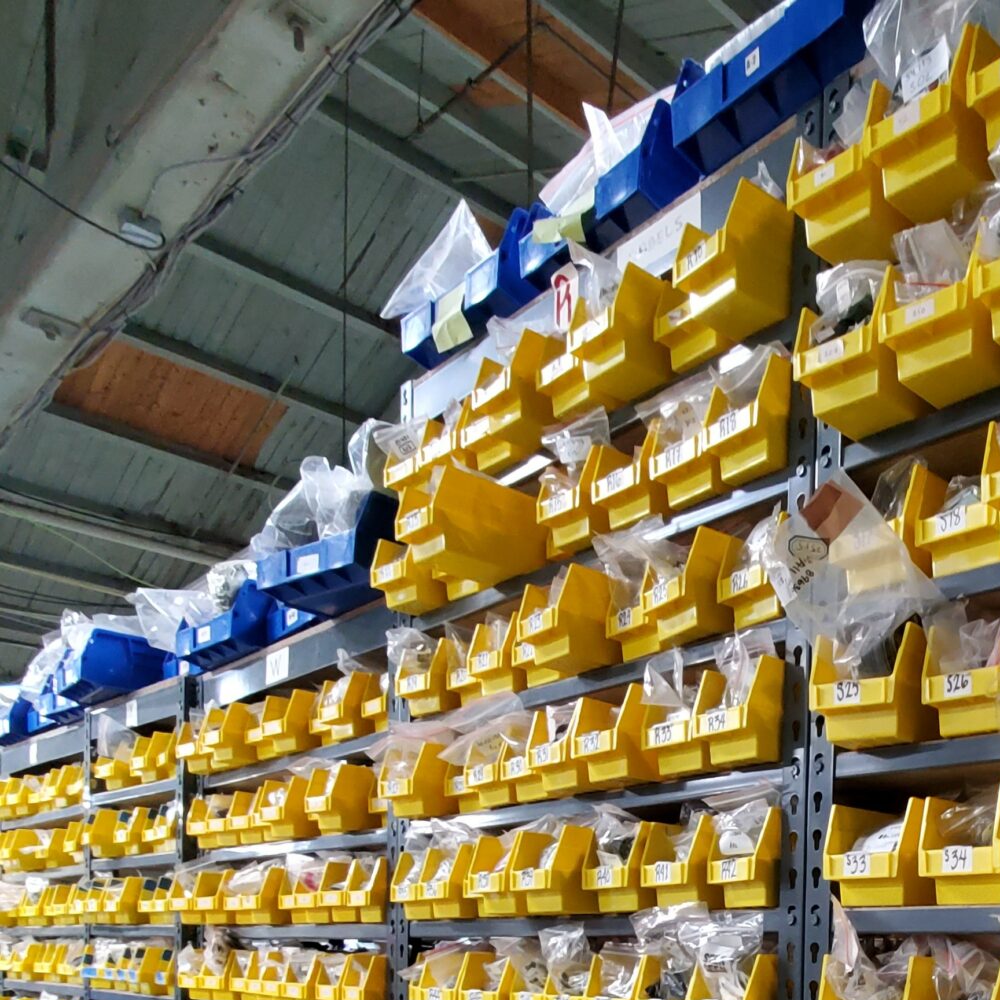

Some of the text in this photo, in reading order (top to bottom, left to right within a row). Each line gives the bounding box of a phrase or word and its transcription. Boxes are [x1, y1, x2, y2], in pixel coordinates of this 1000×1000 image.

[720, 414, 736, 437] R18
[666, 448, 681, 467] R17
[733, 573, 748, 593] R26
[270, 655, 281, 677] W
[837, 682, 858, 702] S25
[947, 674, 968, 692] S26
[708, 714, 725, 731] R34
[584, 734, 599, 753] R32
[655, 725, 672, 744] R33
[847, 854, 866, 874] S33
[945, 849, 966, 870] S34
[597, 868, 611, 884] R40
[656, 863, 668, 882] R41
[721, 860, 736, 879] R42
